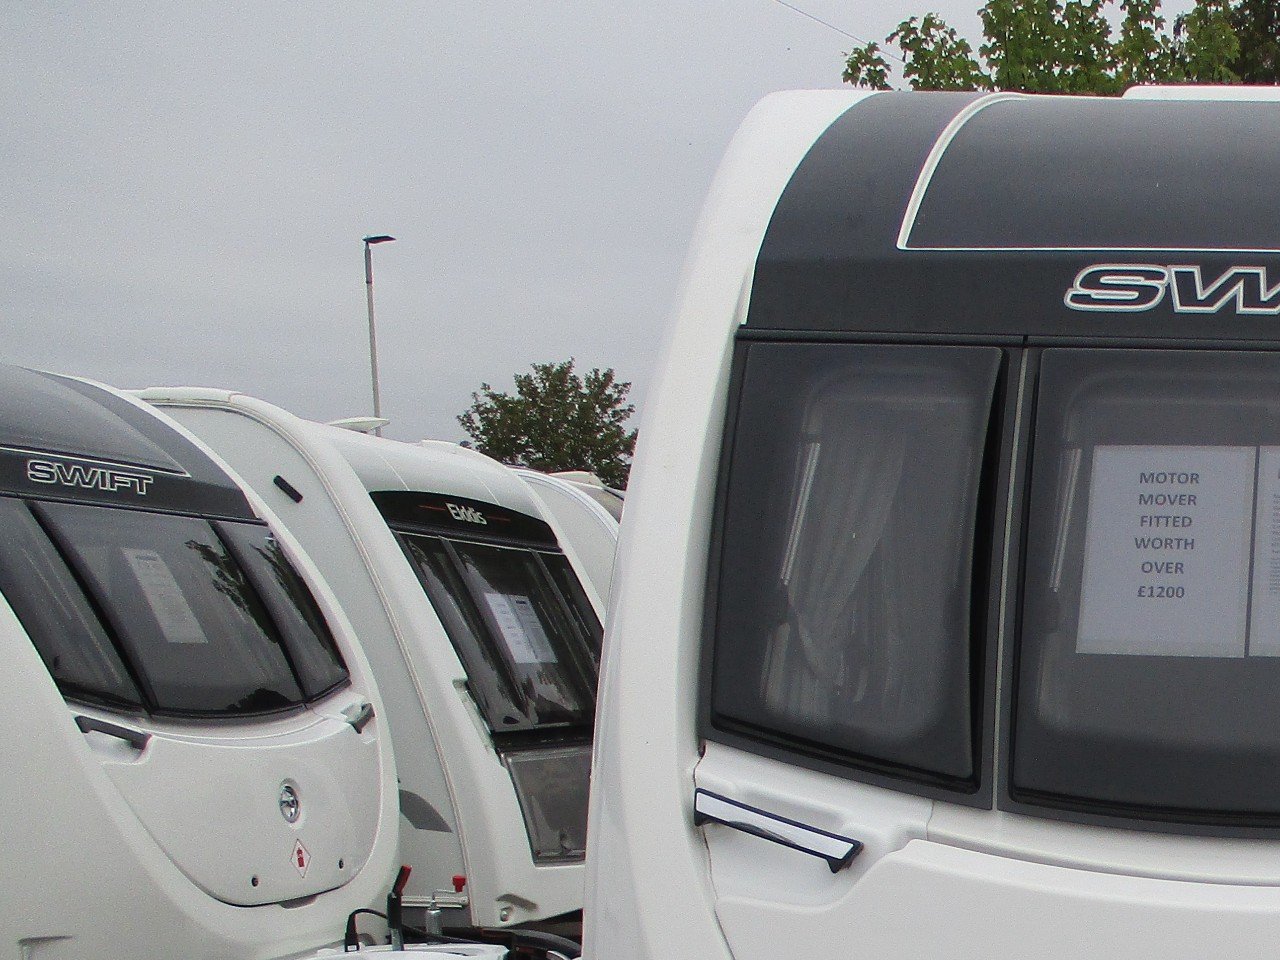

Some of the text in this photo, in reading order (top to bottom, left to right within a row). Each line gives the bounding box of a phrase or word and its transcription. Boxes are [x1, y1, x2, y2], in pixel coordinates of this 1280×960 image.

[27, 460, 153, 495] SWIFT
[1139, 472, 1200, 484] MOTOR
[1138, 493, 1197, 506] MOVER
[1140, 515, 1193, 528] FITTED
[1134, 537, 1195, 550] WORTH
[1141, 561, 1185, 574] OVER
[1137, 585, 1185, 599] £1200
